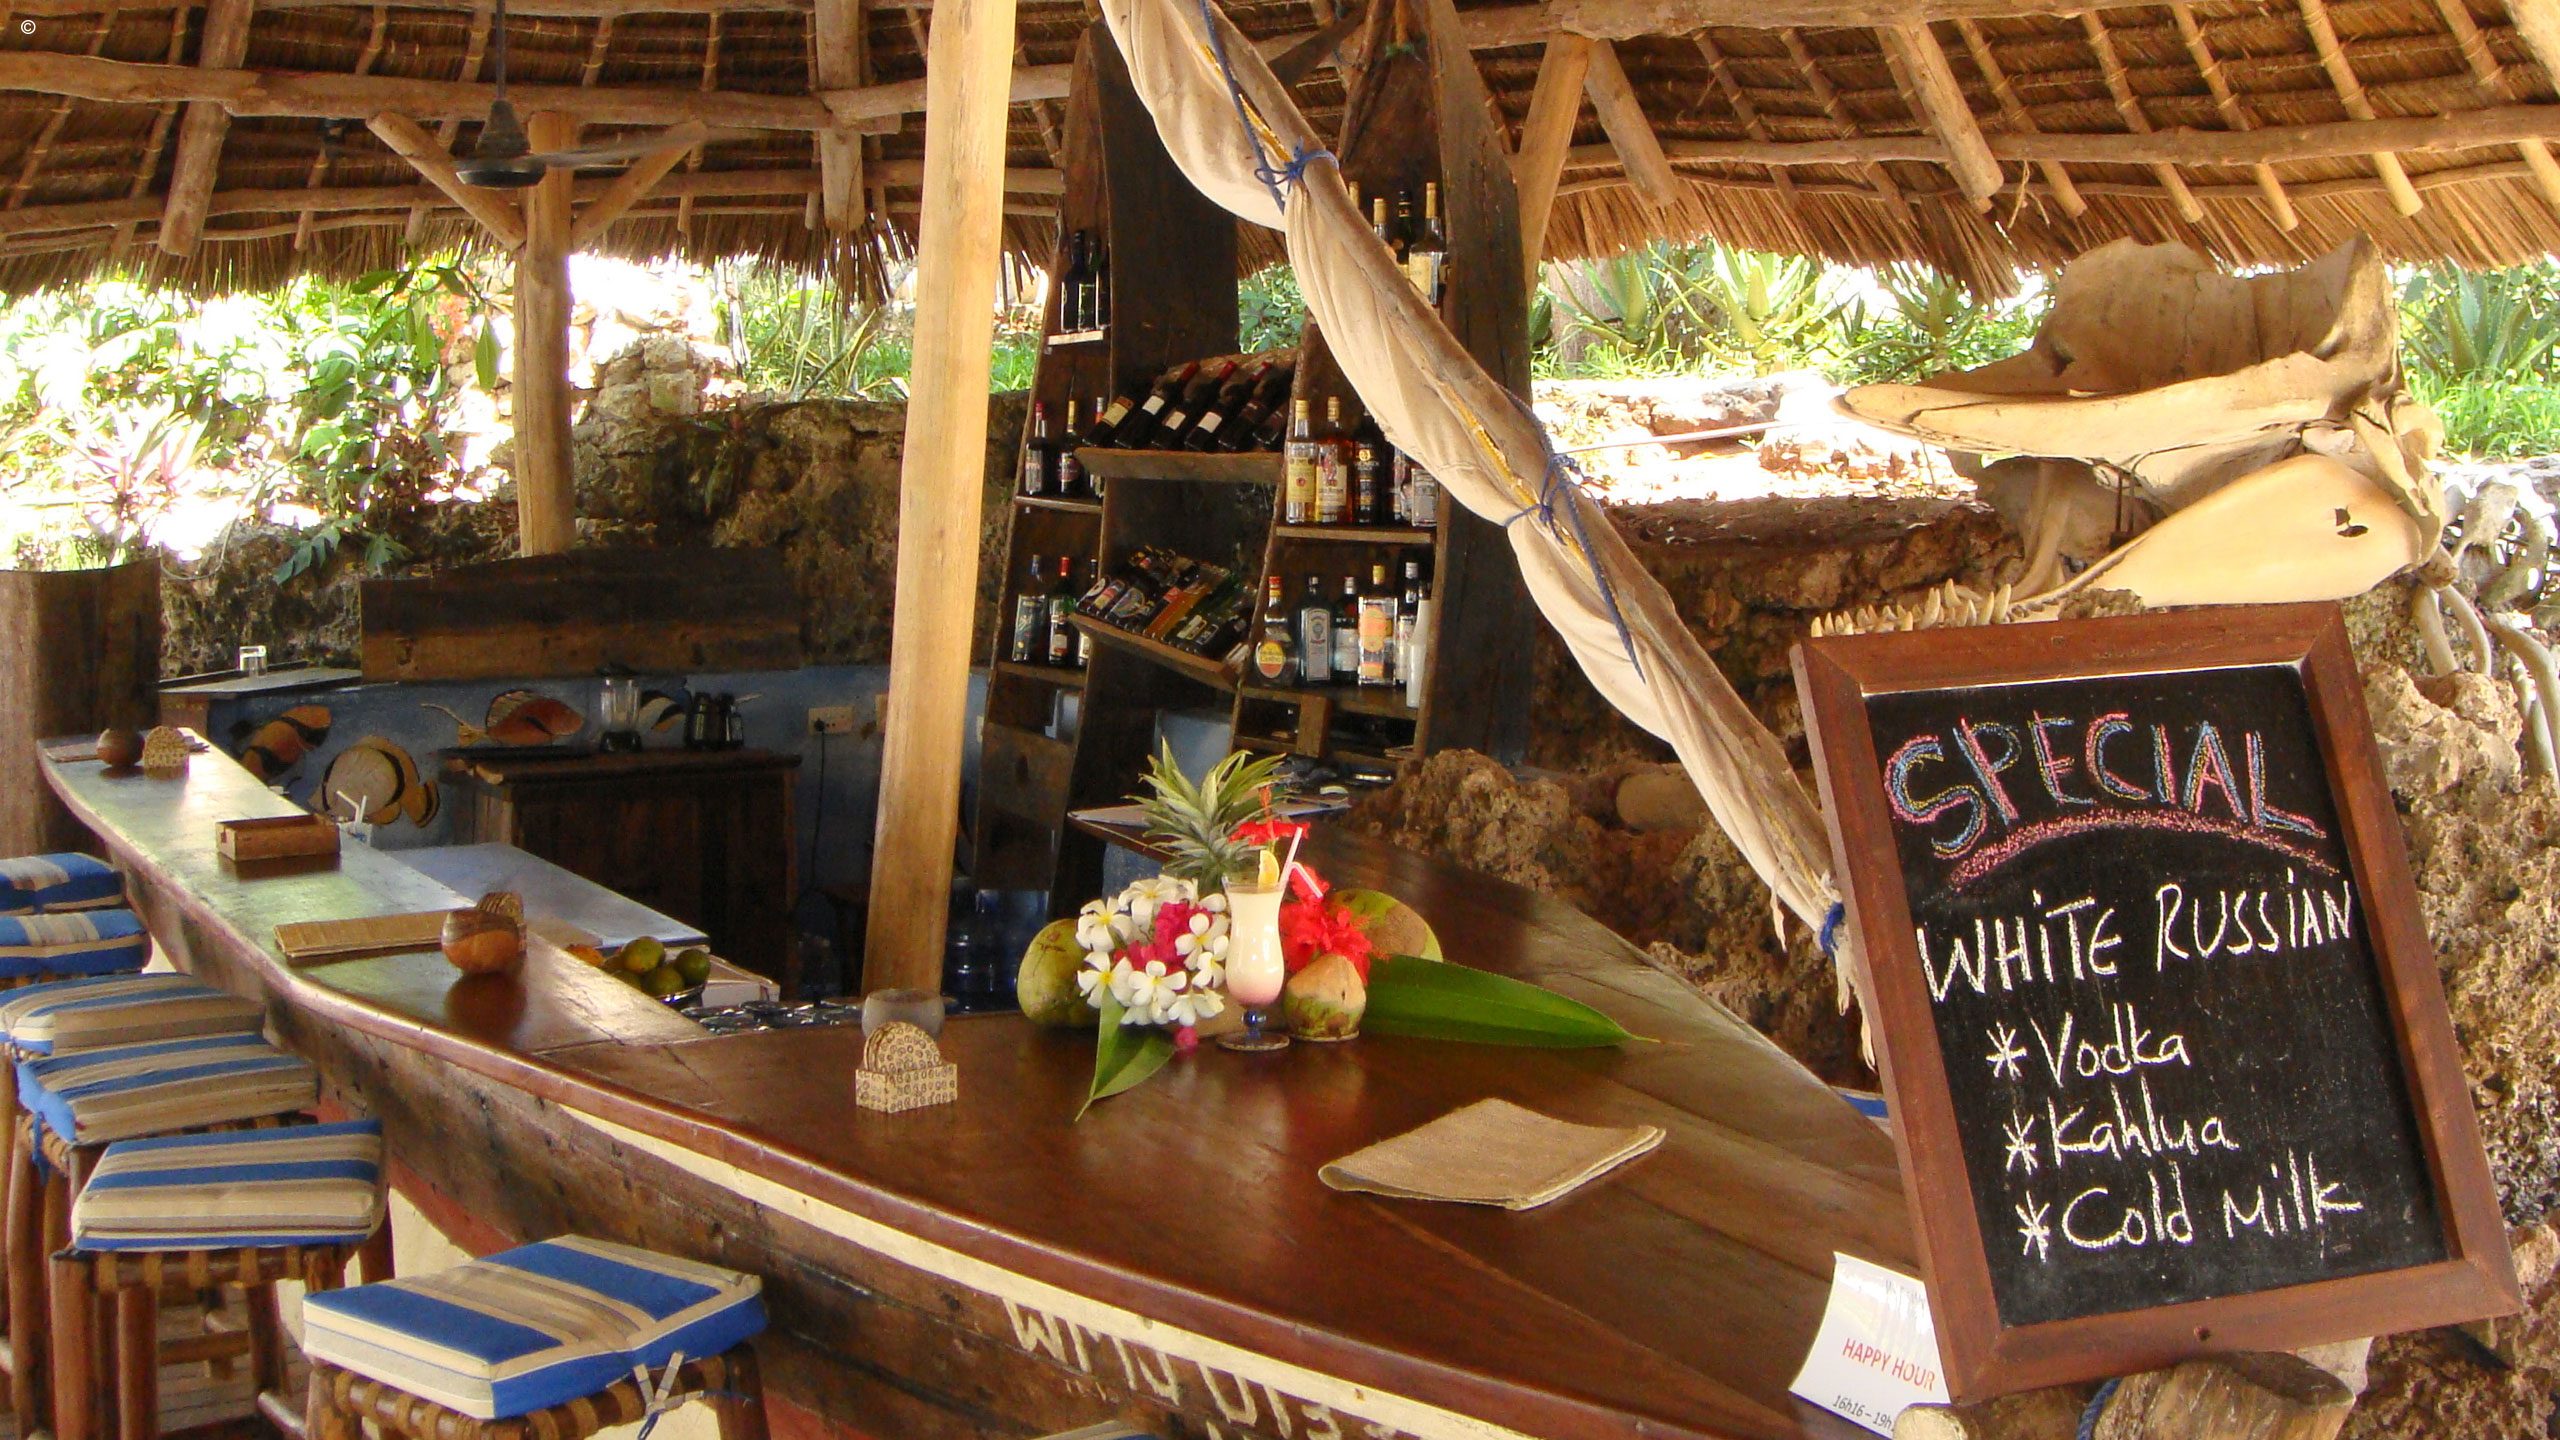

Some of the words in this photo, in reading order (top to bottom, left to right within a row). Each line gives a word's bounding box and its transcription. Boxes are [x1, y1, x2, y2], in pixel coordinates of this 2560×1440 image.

[1884, 710, 2327, 860] SPECIAL
[2033, 1004, 2191, 1089] Vodka
[2047, 1078, 2240, 1168] Kahlua
[2061, 1157, 2195, 1249] Cold
[2222, 1150, 2364, 1242] Milk
[1842, 1337, 1891, 1372] HAPPY
[1892, 1357, 1936, 1392] HOUR
[1832, 1394, 1866, 1417] 16h16
[1872, 1411, 1895, 1432] 19h
